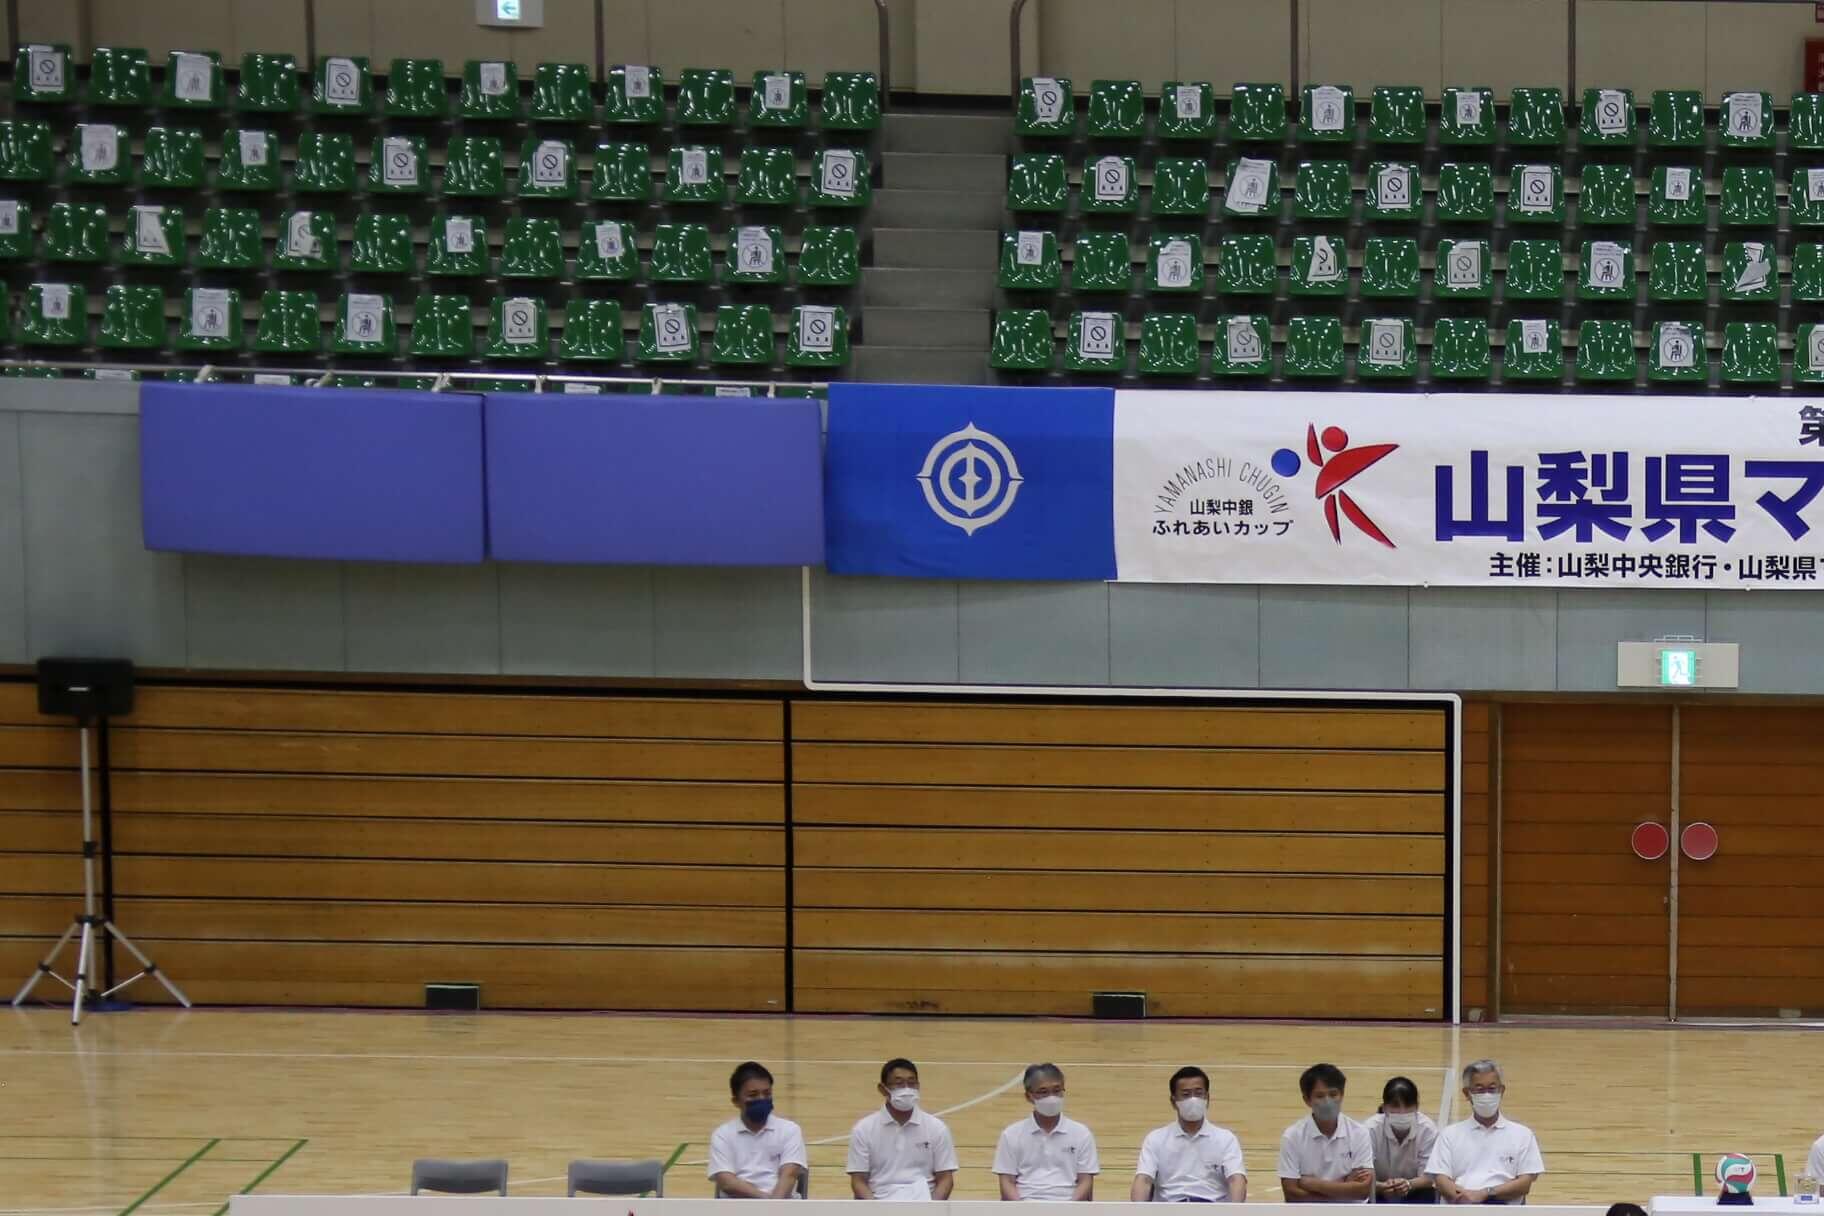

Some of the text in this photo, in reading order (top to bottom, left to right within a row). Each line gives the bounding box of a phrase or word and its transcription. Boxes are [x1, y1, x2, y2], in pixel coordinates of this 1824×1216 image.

[1153, 457, 1290, 515] YAMANASHI CHUGIN
[1190, 499, 1254, 517] 山梨中銀
[1152, 519, 1294, 536] ふれあいカップ
